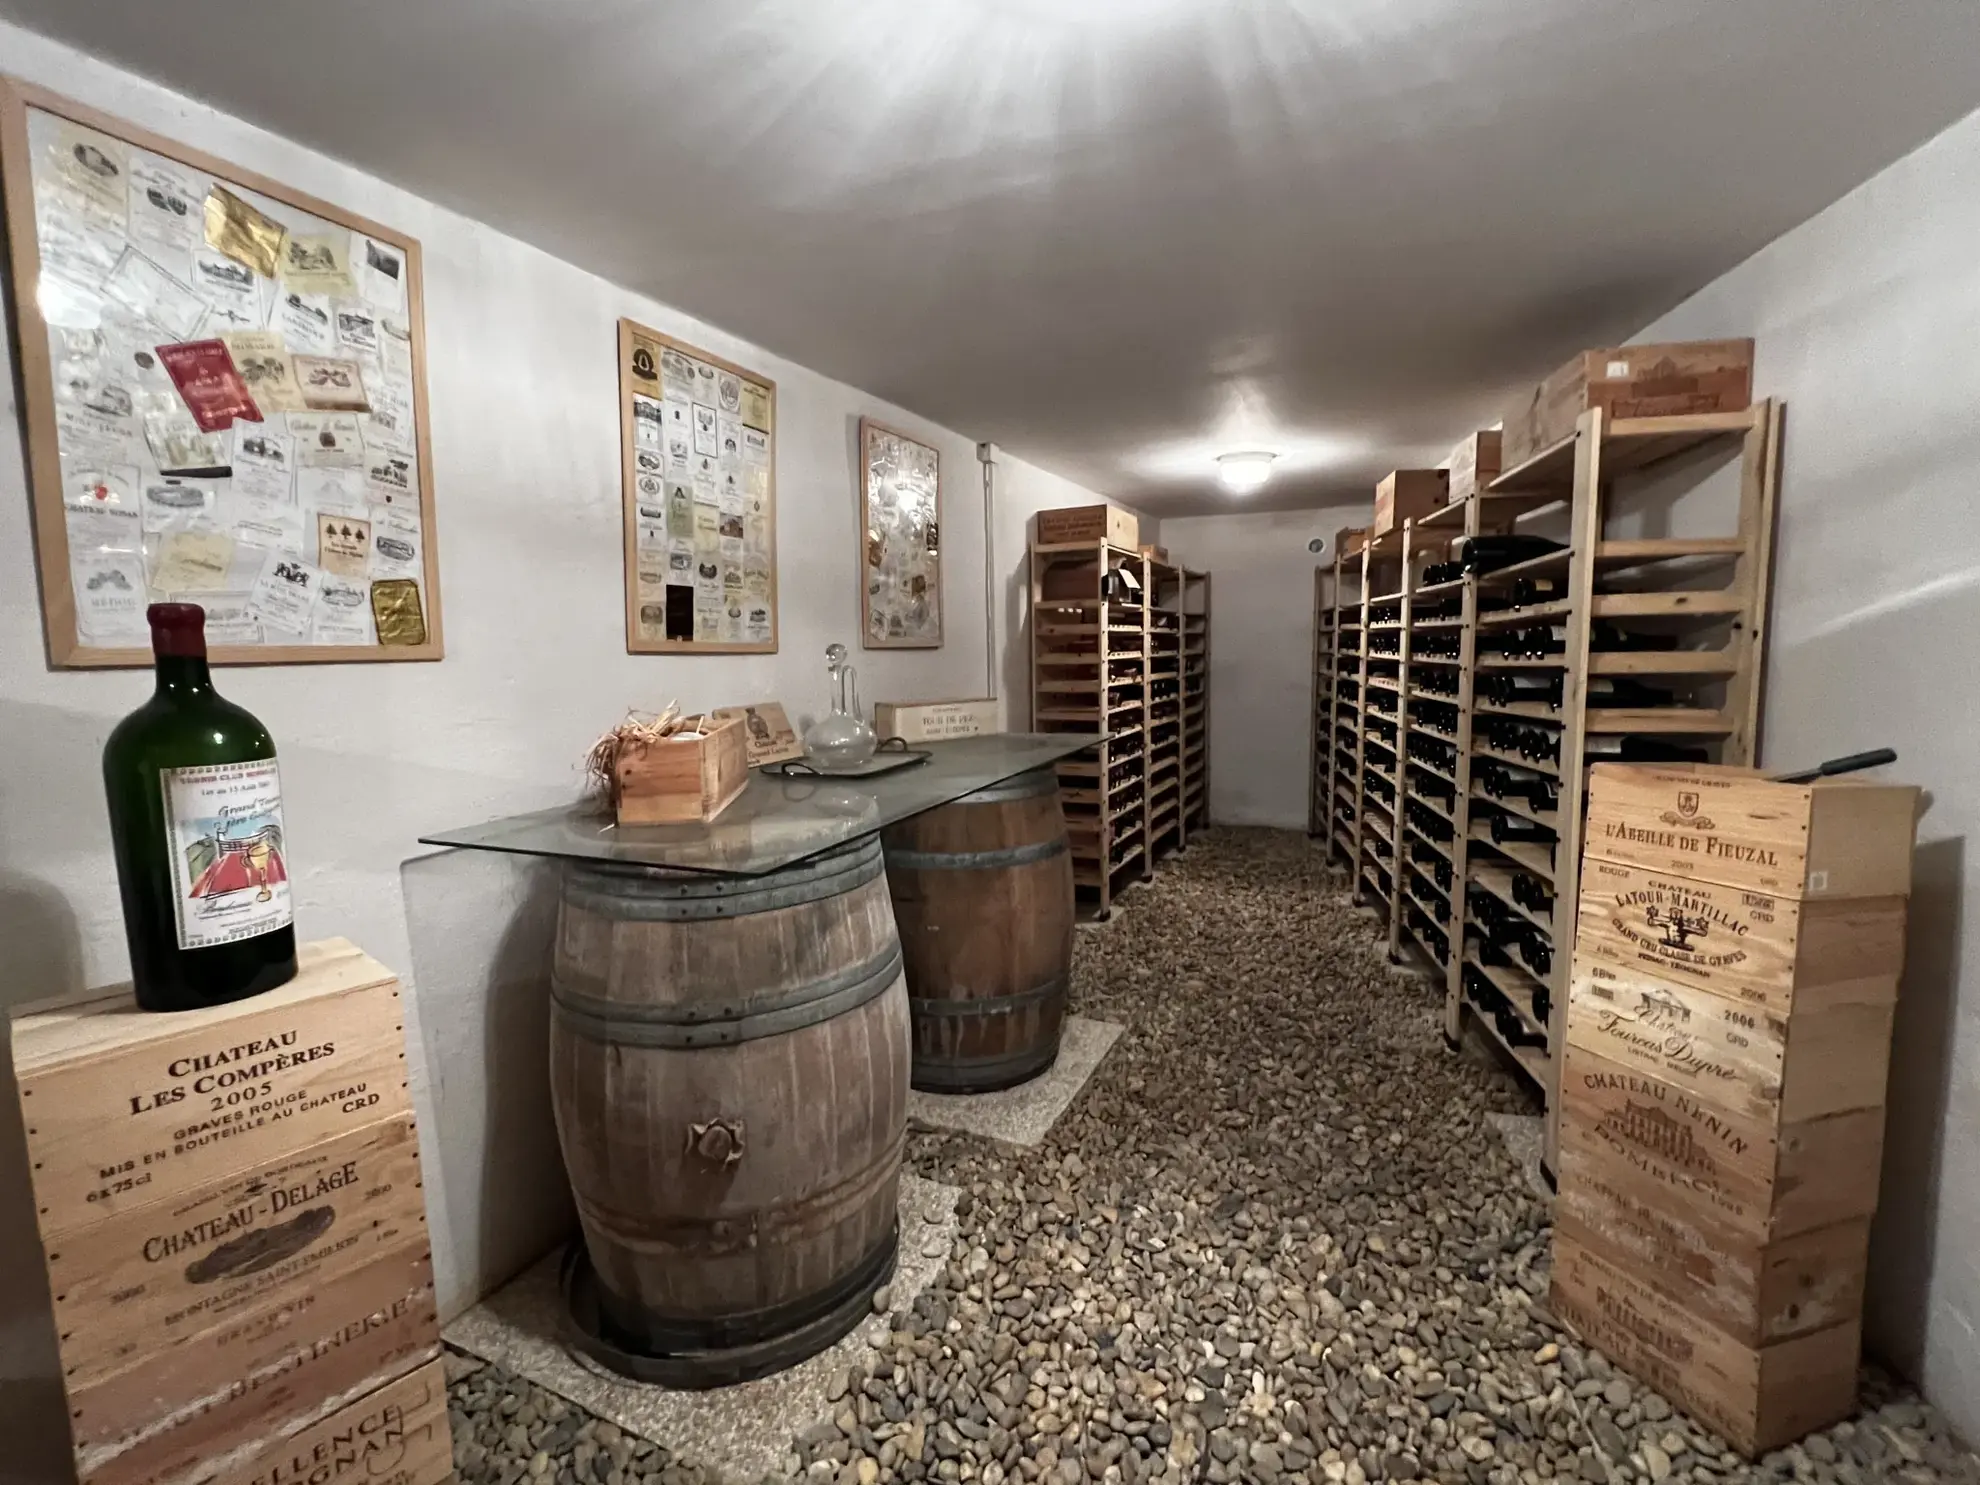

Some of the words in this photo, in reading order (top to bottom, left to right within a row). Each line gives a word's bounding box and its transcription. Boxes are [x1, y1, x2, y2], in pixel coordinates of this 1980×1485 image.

[1680, 836, 1699, 852] DE
[1706, 835, 1778, 867] FIEUZAL
[1648, 880, 1713, 900] CHATEAU
[129, 1086, 186, 1117] LES
[193, 1042, 336, 1096] COMPÈRES
[169, 1030, 299, 1079] CHATEAU
[173, 1111, 245, 1142] GRAVES
[249, 1090, 308, 1117] ROUGE
[210, 1081, 274, 1113] 2005
[341, 1093, 381, 1114] CRD
[1583, 1072, 1667, 1102] CHATEAU
[1675, 1096, 1749, 1155] NENIN
[100, 1160, 136, 1180] MIS
[143, 1150, 167, 1166] EN
[174, 1116, 265, 1155] BOUTEILLE
[271, 1107, 294, 1123] AU
[299, 1082, 368, 1112] CHATEAU
[142, 1204, 254, 1263] CHATEAU
